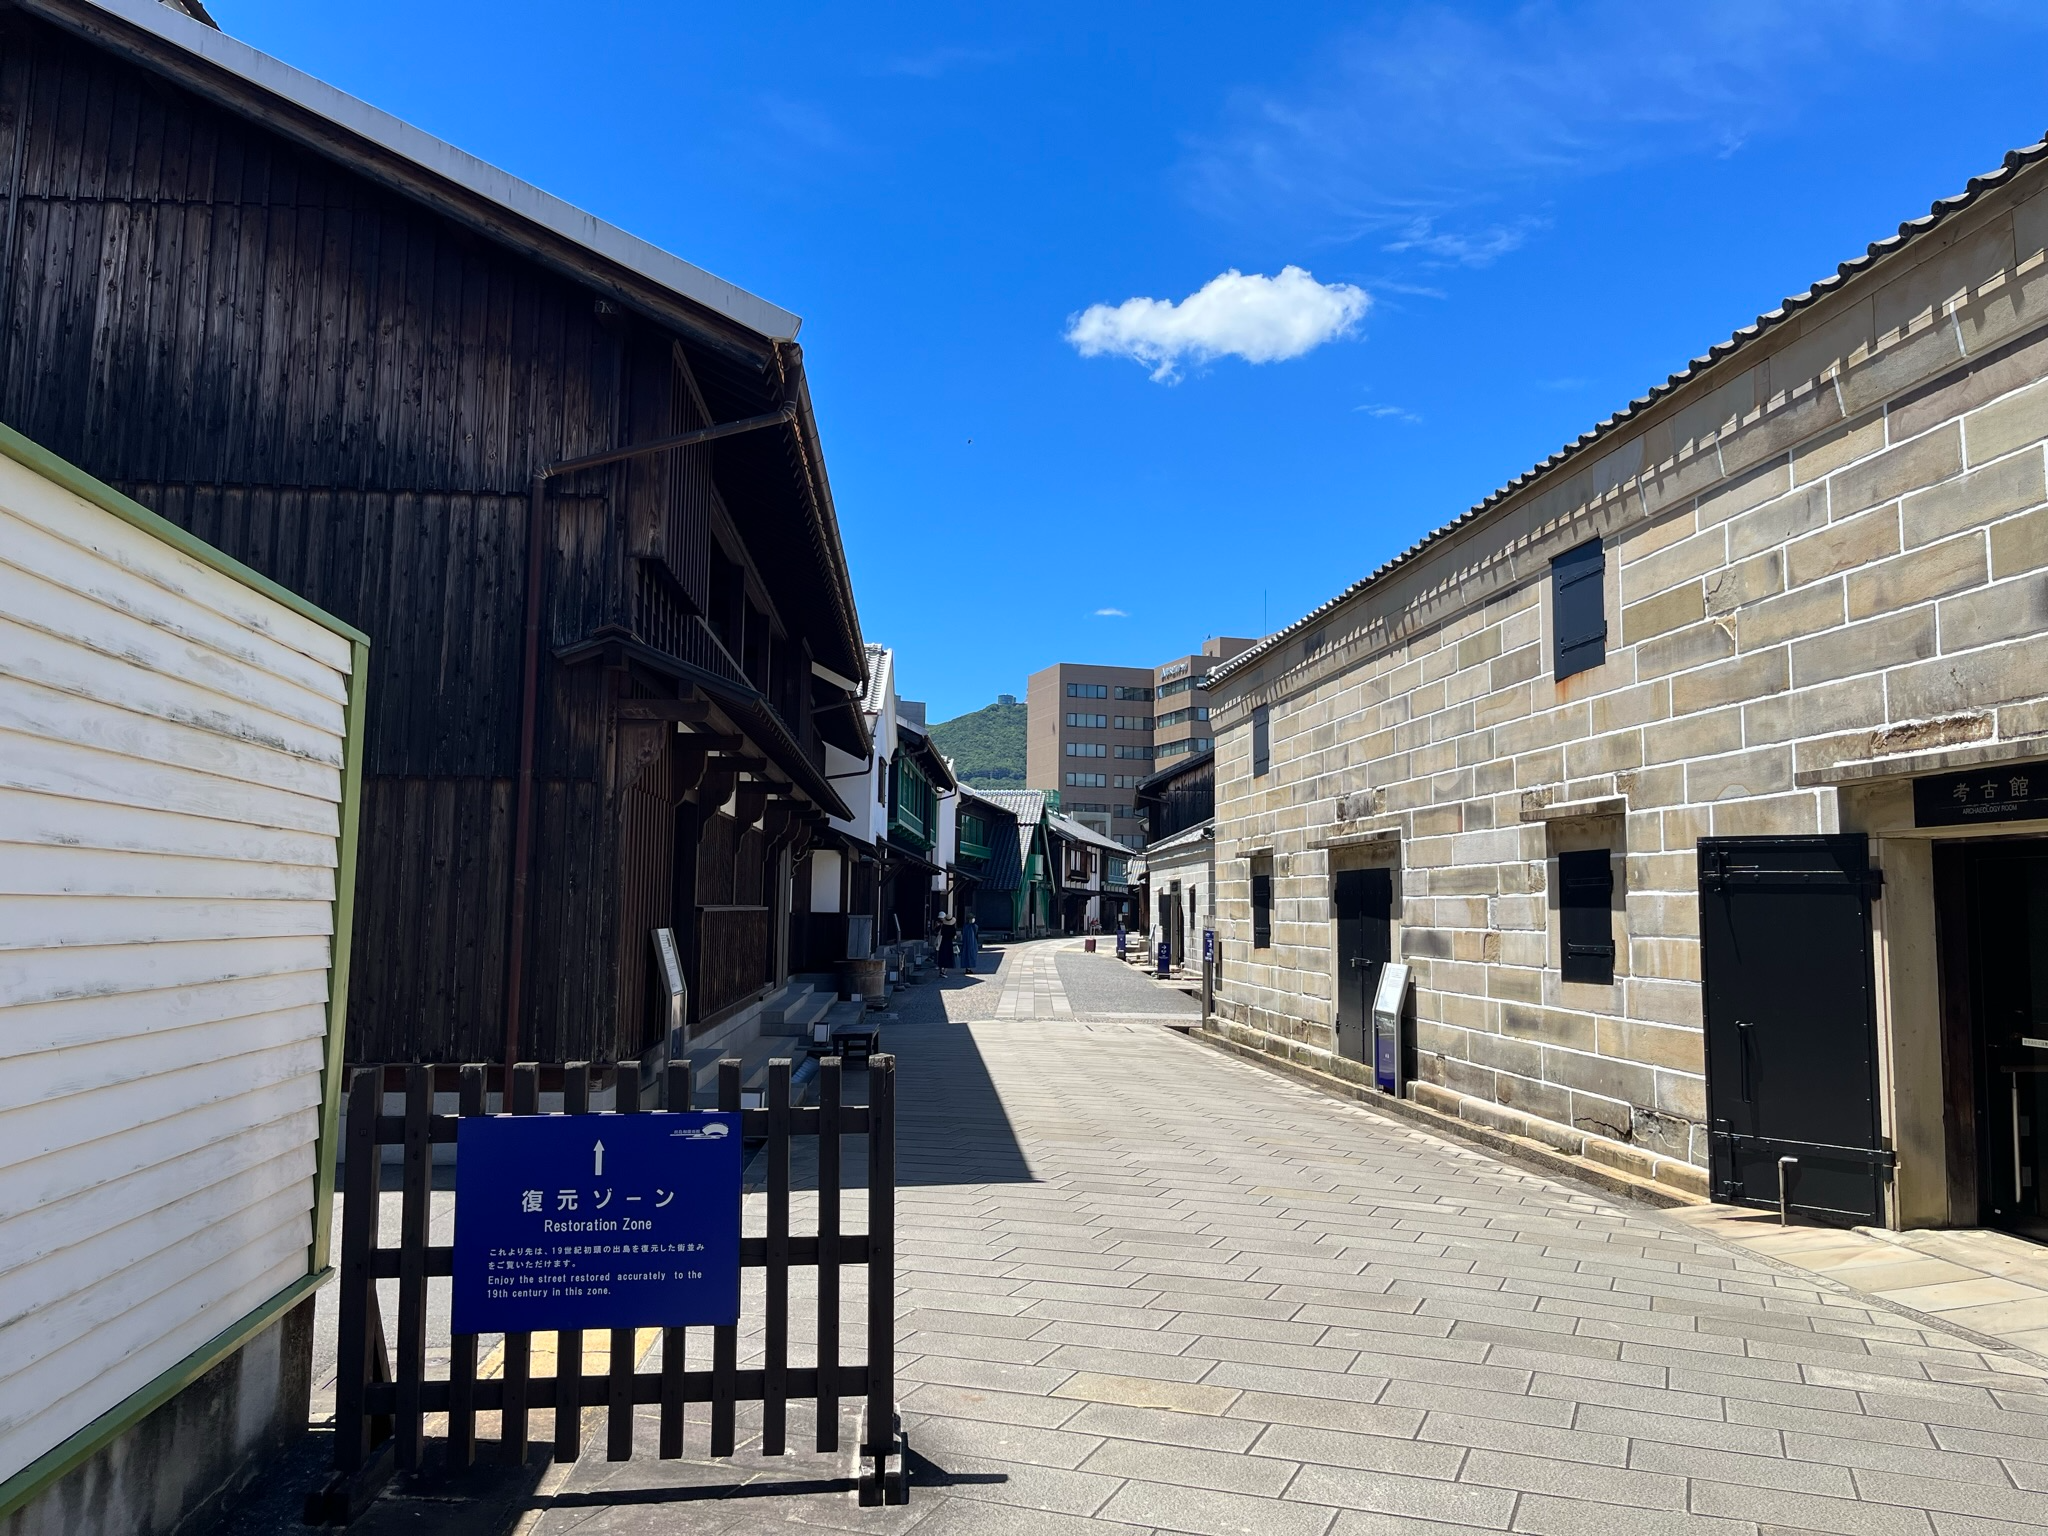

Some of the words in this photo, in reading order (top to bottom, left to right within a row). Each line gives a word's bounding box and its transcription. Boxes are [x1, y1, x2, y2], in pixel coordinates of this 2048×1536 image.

[1953, 776, 2029, 803] 考古館
[1962, 805, 2000, 815] ARCHAEOLOGY
[2001, 804, 2018, 812] ROOM
[521, 1187, 674, 1213] 復元ゾーン
[544, 1218, 617, 1232] Restoration
[622, 1217, 652, 1230] Zone
[488, 1259, 576, 1270] をご覧いただけます。
[488, 1275, 515, 1285] Enjoy
[519, 1275, 534, 1284] the
[538, 1274, 566, 1283] street
[570, 1272, 610, 1282] restored
[617, 1271, 666, 1280] accurately
[674, 1271, 684, 1279] to
[687, 1270, 702, 1279] the
[487, 1289, 508, 1298] 19th
[512, 1288, 548, 1297] century
[552, 1287, 561, 1296] in
[565, 1286, 583, 1296] this
[587, 1287, 611, 1295] zone.
